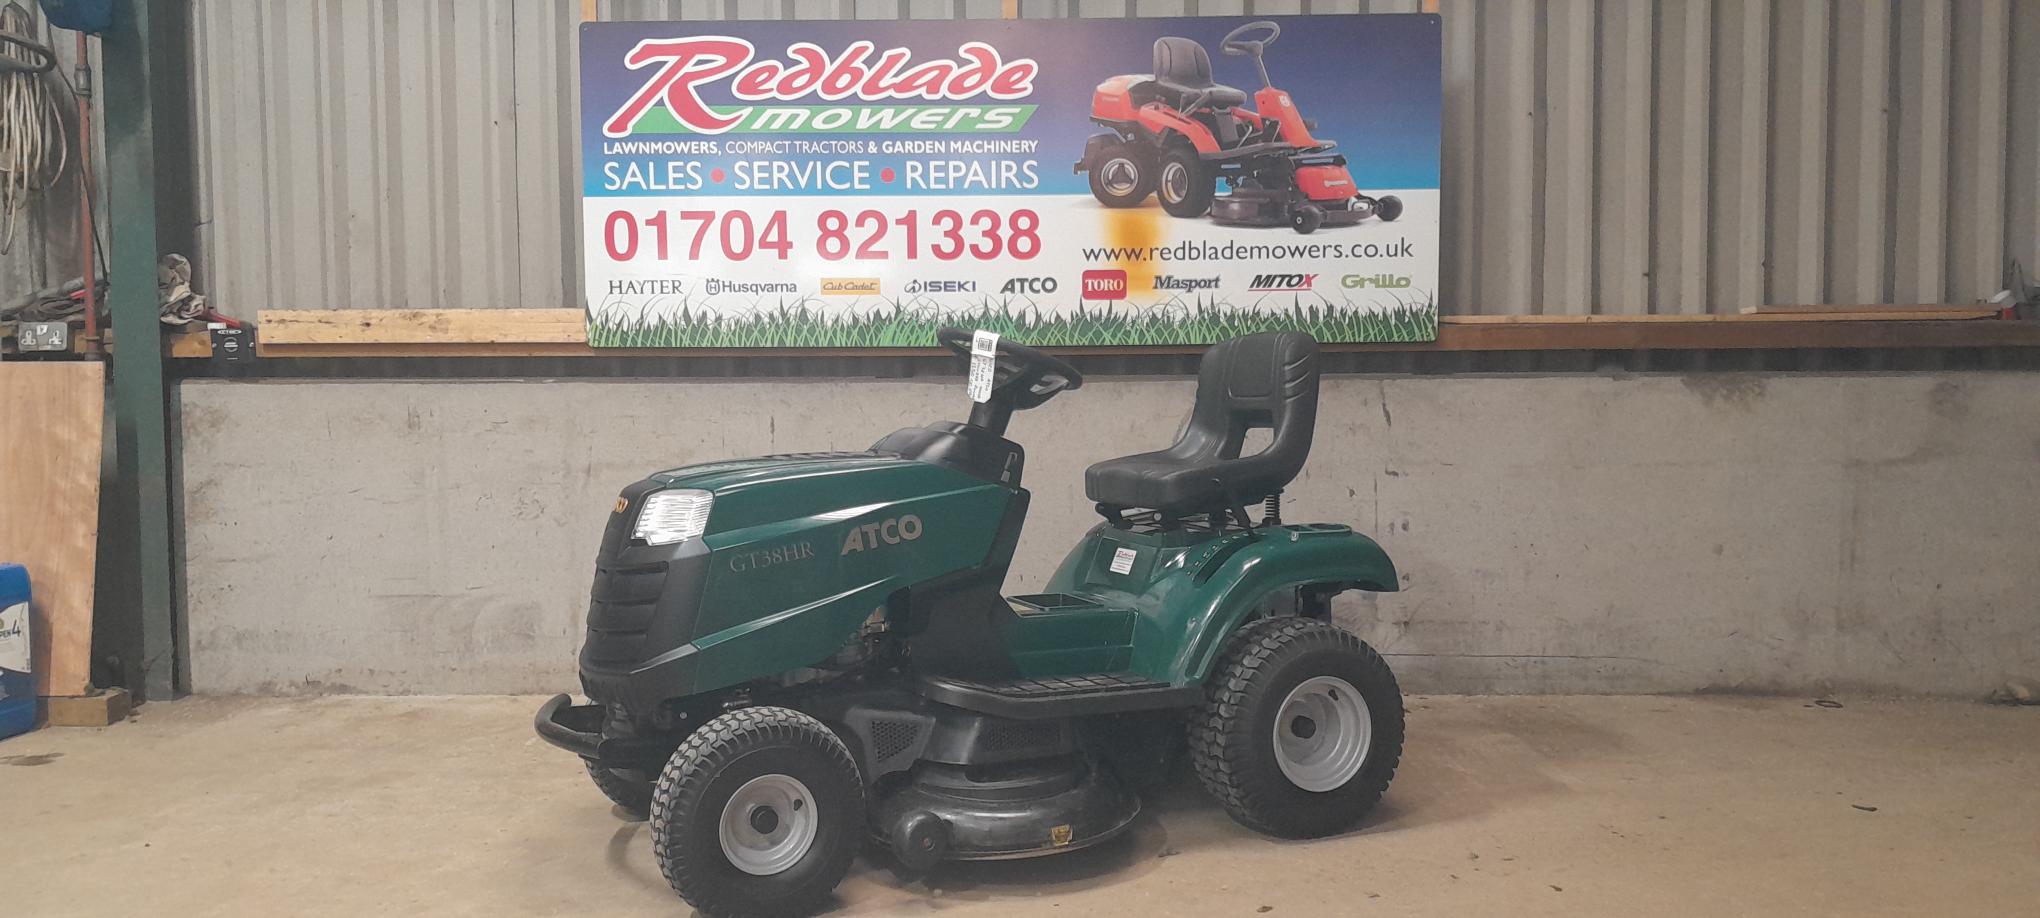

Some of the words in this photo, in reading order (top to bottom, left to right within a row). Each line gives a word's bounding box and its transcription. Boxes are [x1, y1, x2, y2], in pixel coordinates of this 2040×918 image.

[603, 35, 1038, 138] Redblade
[751, 107, 1021, 130] mowers
[604, 142, 722, 156] LAWNMOWERS,
[725, 141, 792, 155] COMPACT
[796, 141, 864, 154] TRACTORS
[867, 141, 878, 154] &
[882, 141, 945, 154] GARDEN
[950, 140, 1039, 154] MACHINERY
[604, 161, 703, 190] SALES
[734, 161, 871, 190] SERVICE
[906, 160, 1039, 190] REPAIRS
[604, 209, 793, 262] 01704
[816, 209, 1042, 261] 821338
[1082, 237, 1414, 262] www.redblademowers.co.uk
[609, 280, 684, 295] HAYTER
[722, 281, 797, 296] Husqvarna
[823, 282, 843, 290] Cub
[844, 282, 878, 290] Cadet
[924, 281, 976, 292] ISEKI
[1000, 277, 1058, 294] ATCO
[1085, 278, 1124, 291] TORO
[1153, 275, 1221, 292] Masport
[1249, 274, 1319, 289] MITOX
[1341, 274, 1411, 288] Grillo
[840, 514, 923, 556] ATCO
[730, 541, 815, 573] GT38HR
